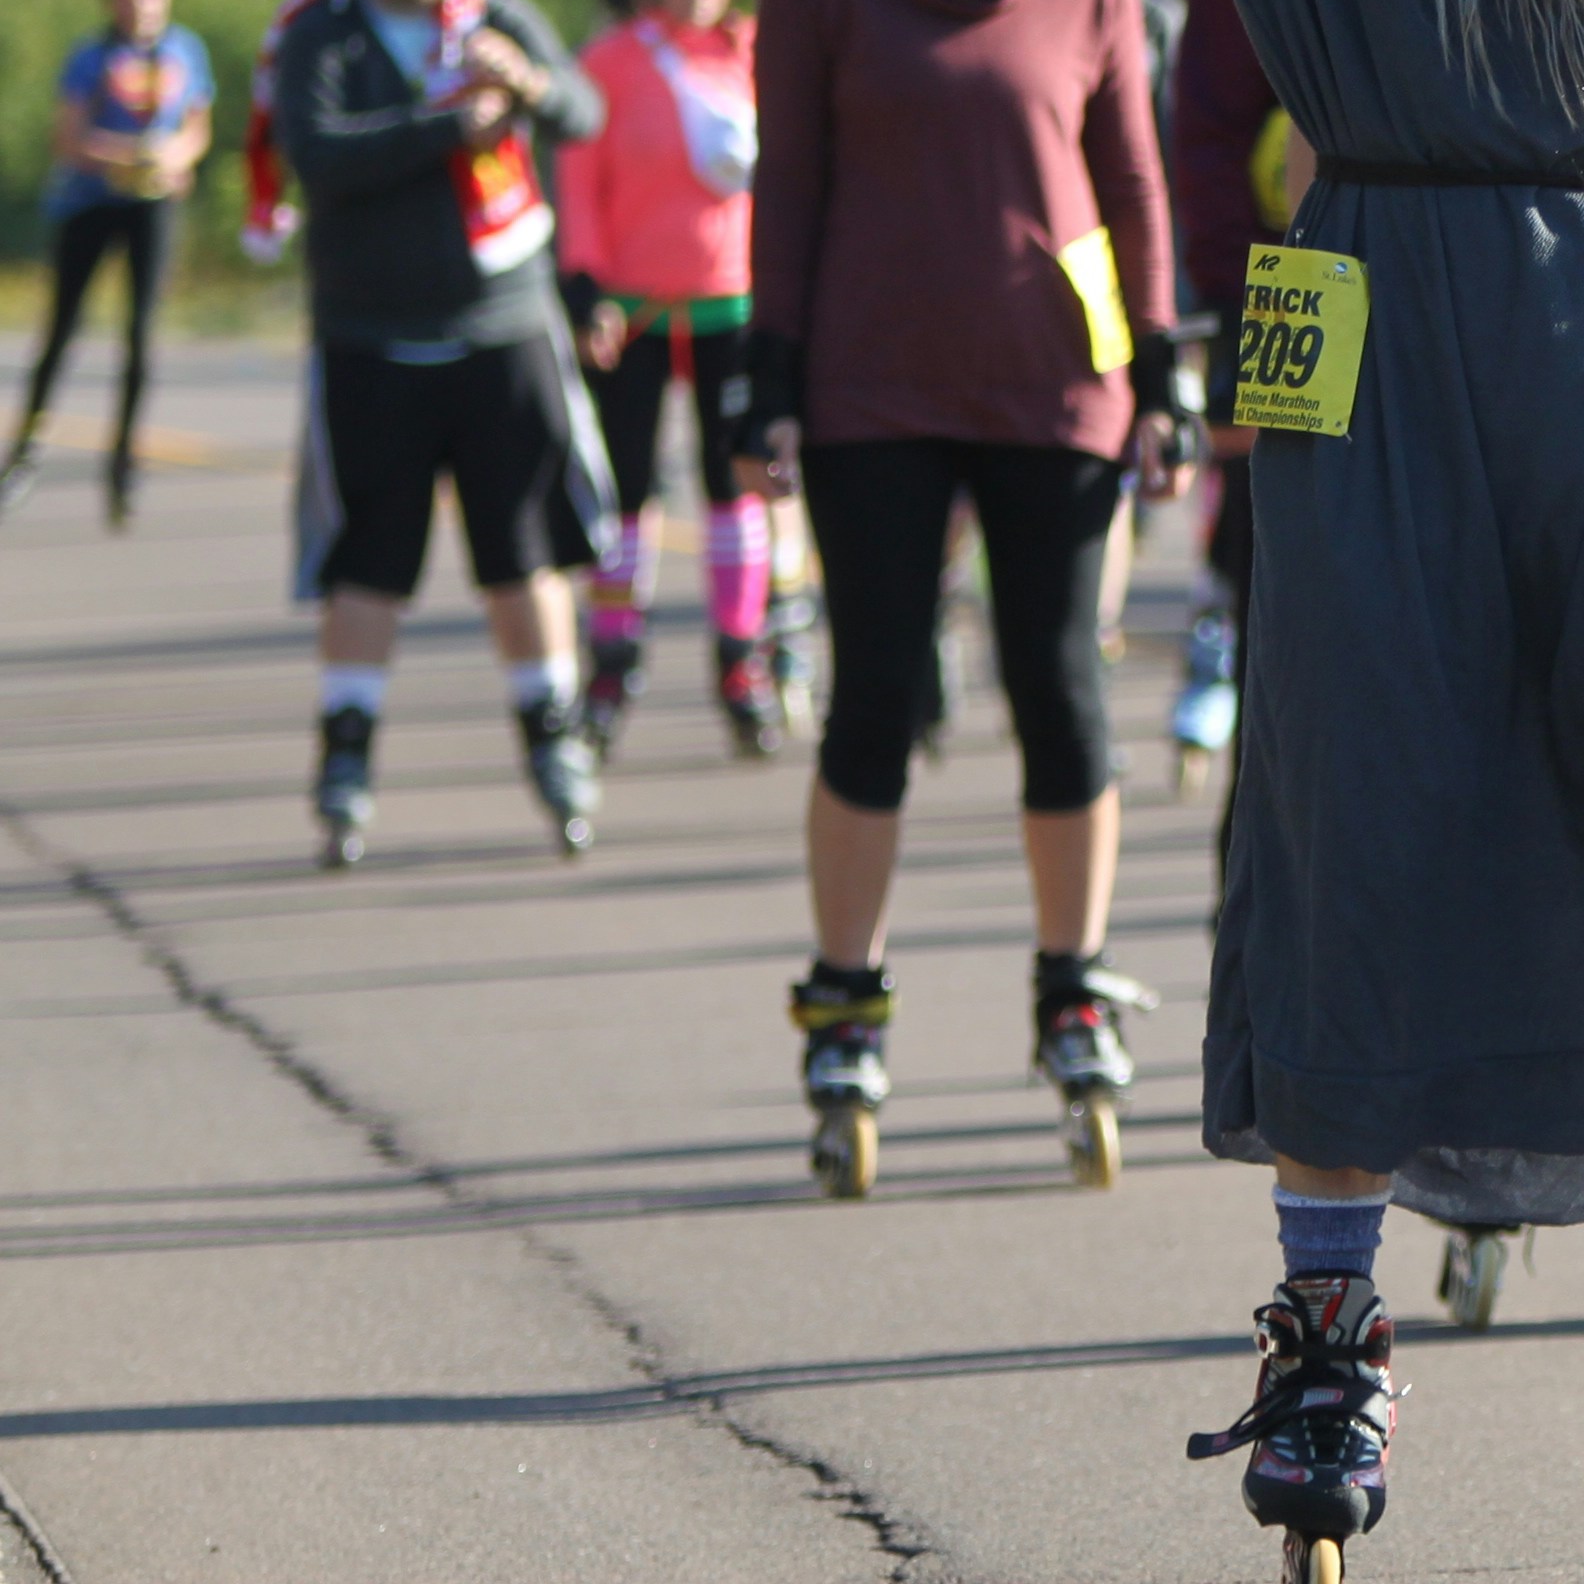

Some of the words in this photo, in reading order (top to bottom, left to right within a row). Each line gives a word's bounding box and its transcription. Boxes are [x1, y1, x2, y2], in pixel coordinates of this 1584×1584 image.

[1253, 254, 1281, 271] K2
[1238, 319, 1324, 388] 209
[1241, 390, 1268, 407] Inline
[1269, 392, 1320, 412] Marathon
[1246, 407, 1324, 431] Championships
